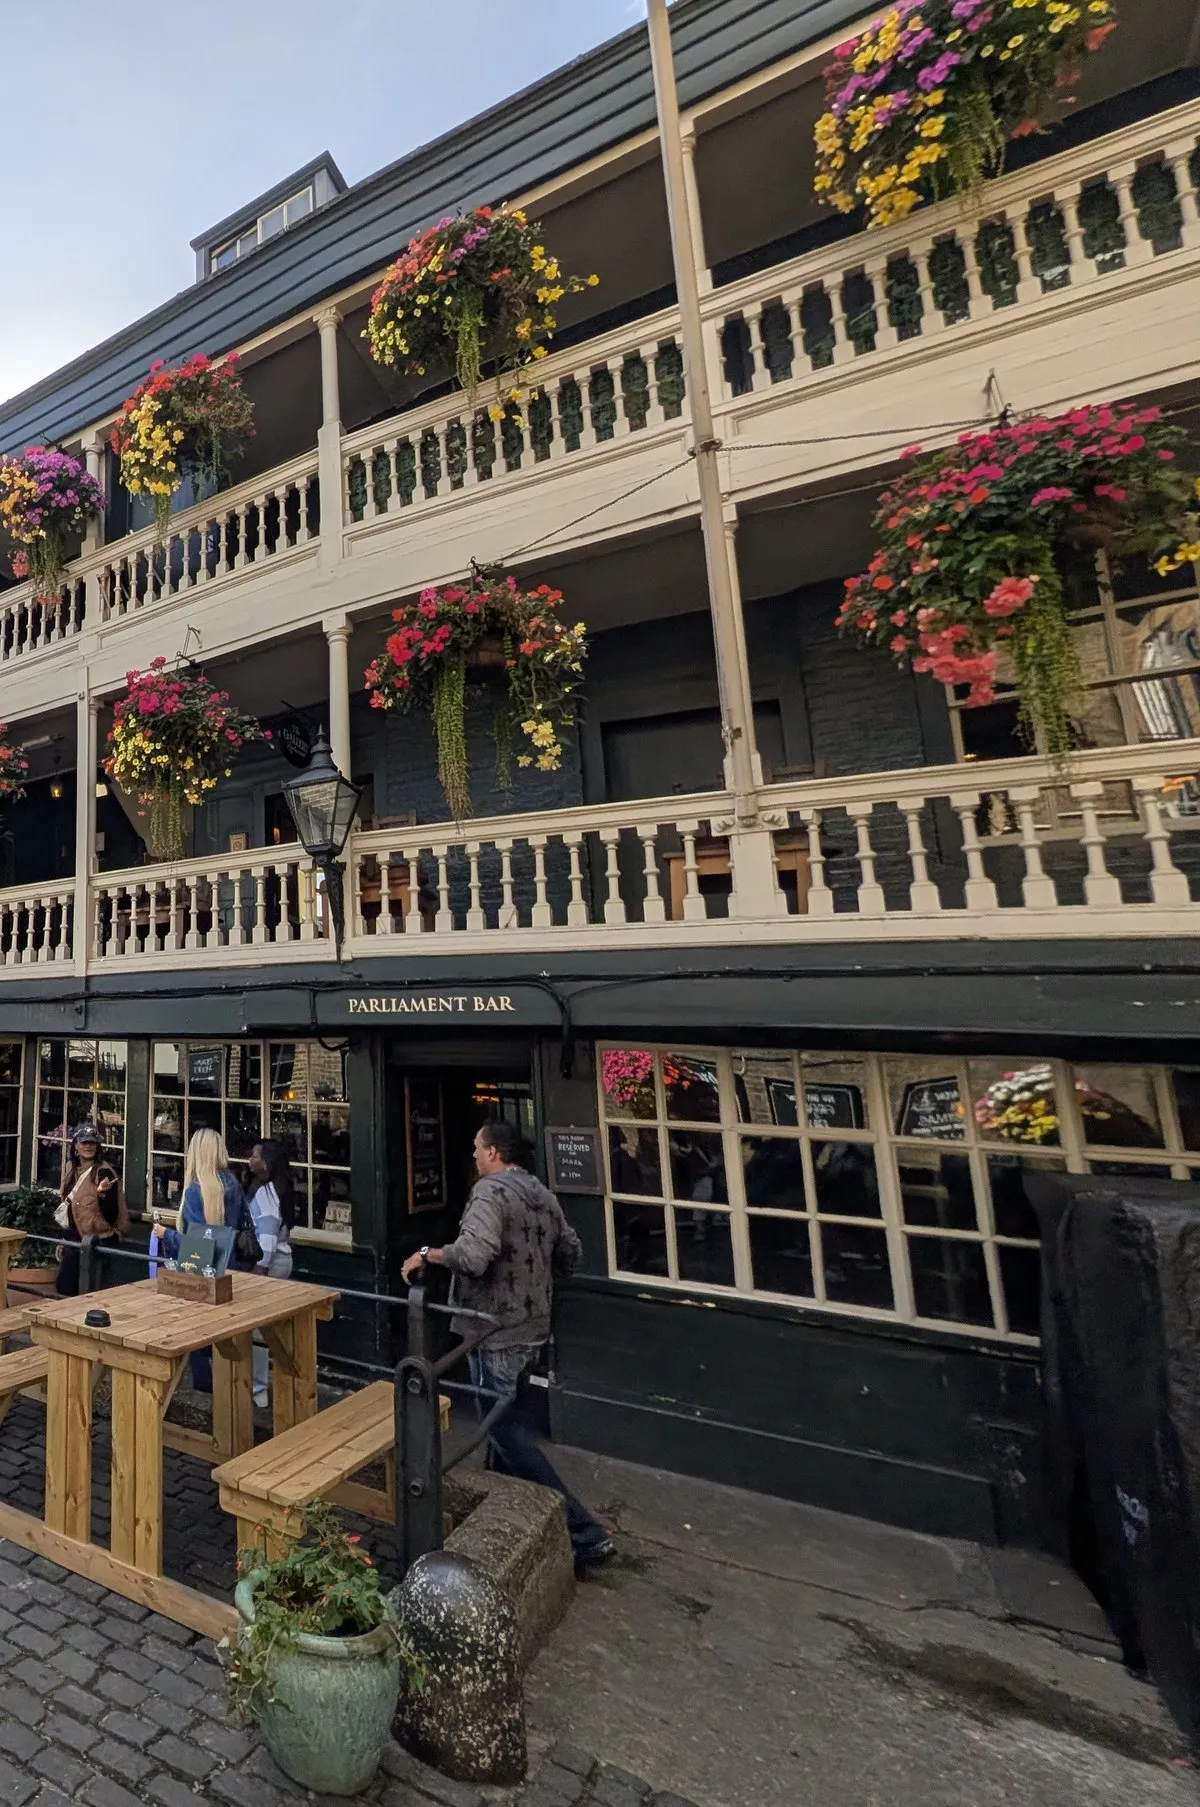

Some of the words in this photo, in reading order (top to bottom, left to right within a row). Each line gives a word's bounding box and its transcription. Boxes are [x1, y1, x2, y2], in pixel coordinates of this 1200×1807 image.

[348, 997, 468, 1014] PARLIAMENT
[472, 995, 517, 1012] BAR
[557, 1143, 591, 1152] RESERVED
